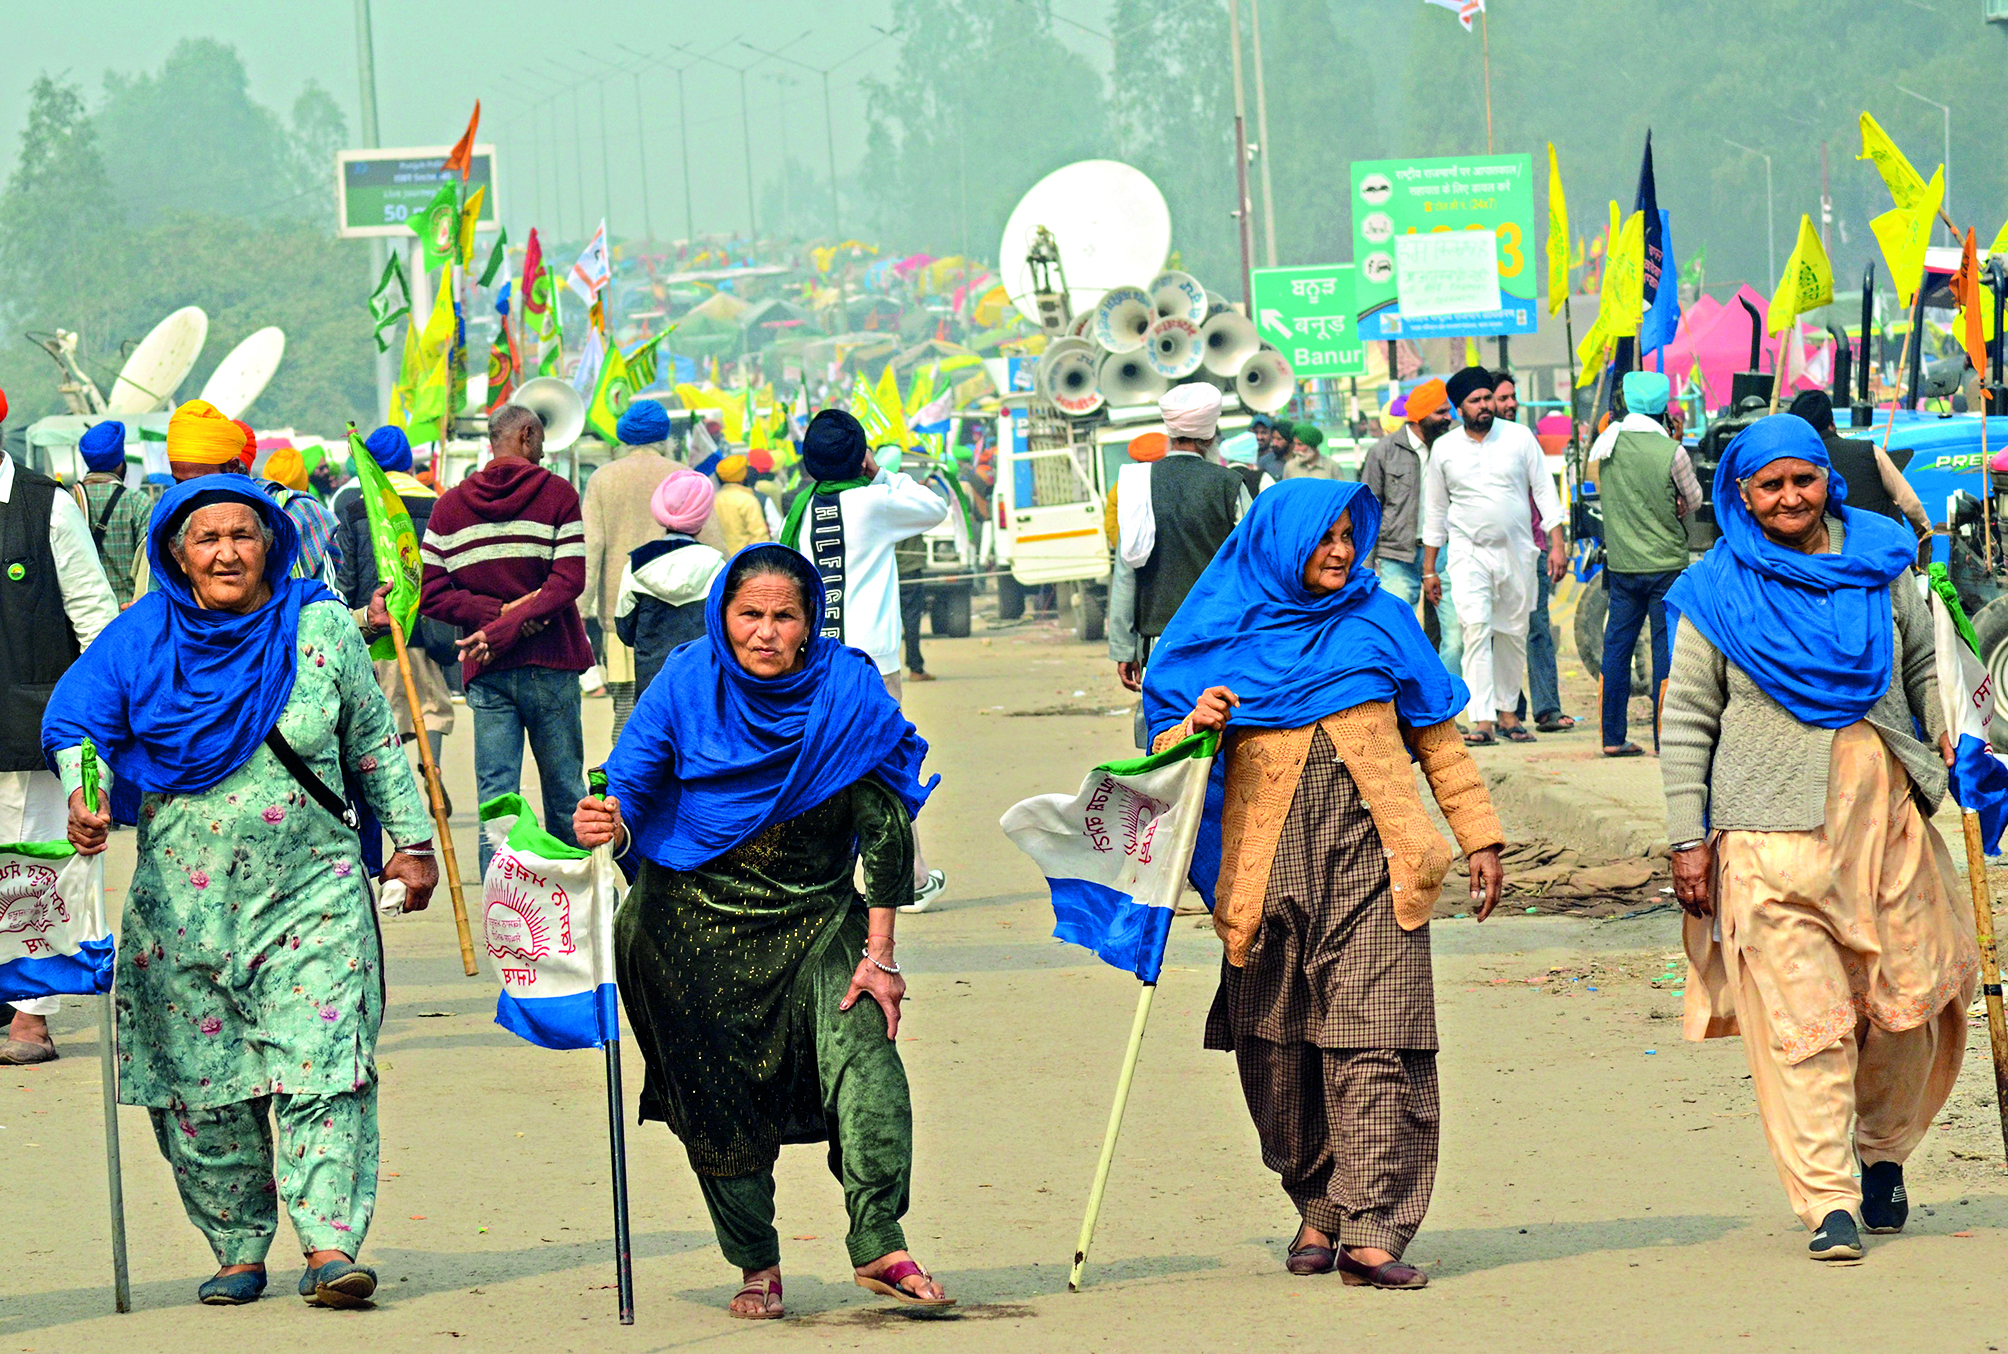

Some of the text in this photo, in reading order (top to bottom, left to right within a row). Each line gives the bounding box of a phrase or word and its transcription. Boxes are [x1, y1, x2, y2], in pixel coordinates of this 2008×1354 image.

[1459, 167, 1471, 177] पर
[1409, 185, 1440, 197] सहायता
[1441, 182, 1451, 194] के
[1452, 181, 1470, 195] लिए
[1497, 179, 1511, 192] करें
[384, 204, 408, 222] 50
[1290, 278, 1338, 304] ਬਨੂੜ
[1293, 315, 1345, 340] बनूड़
[1294, 348, 1362, 366] Banur
